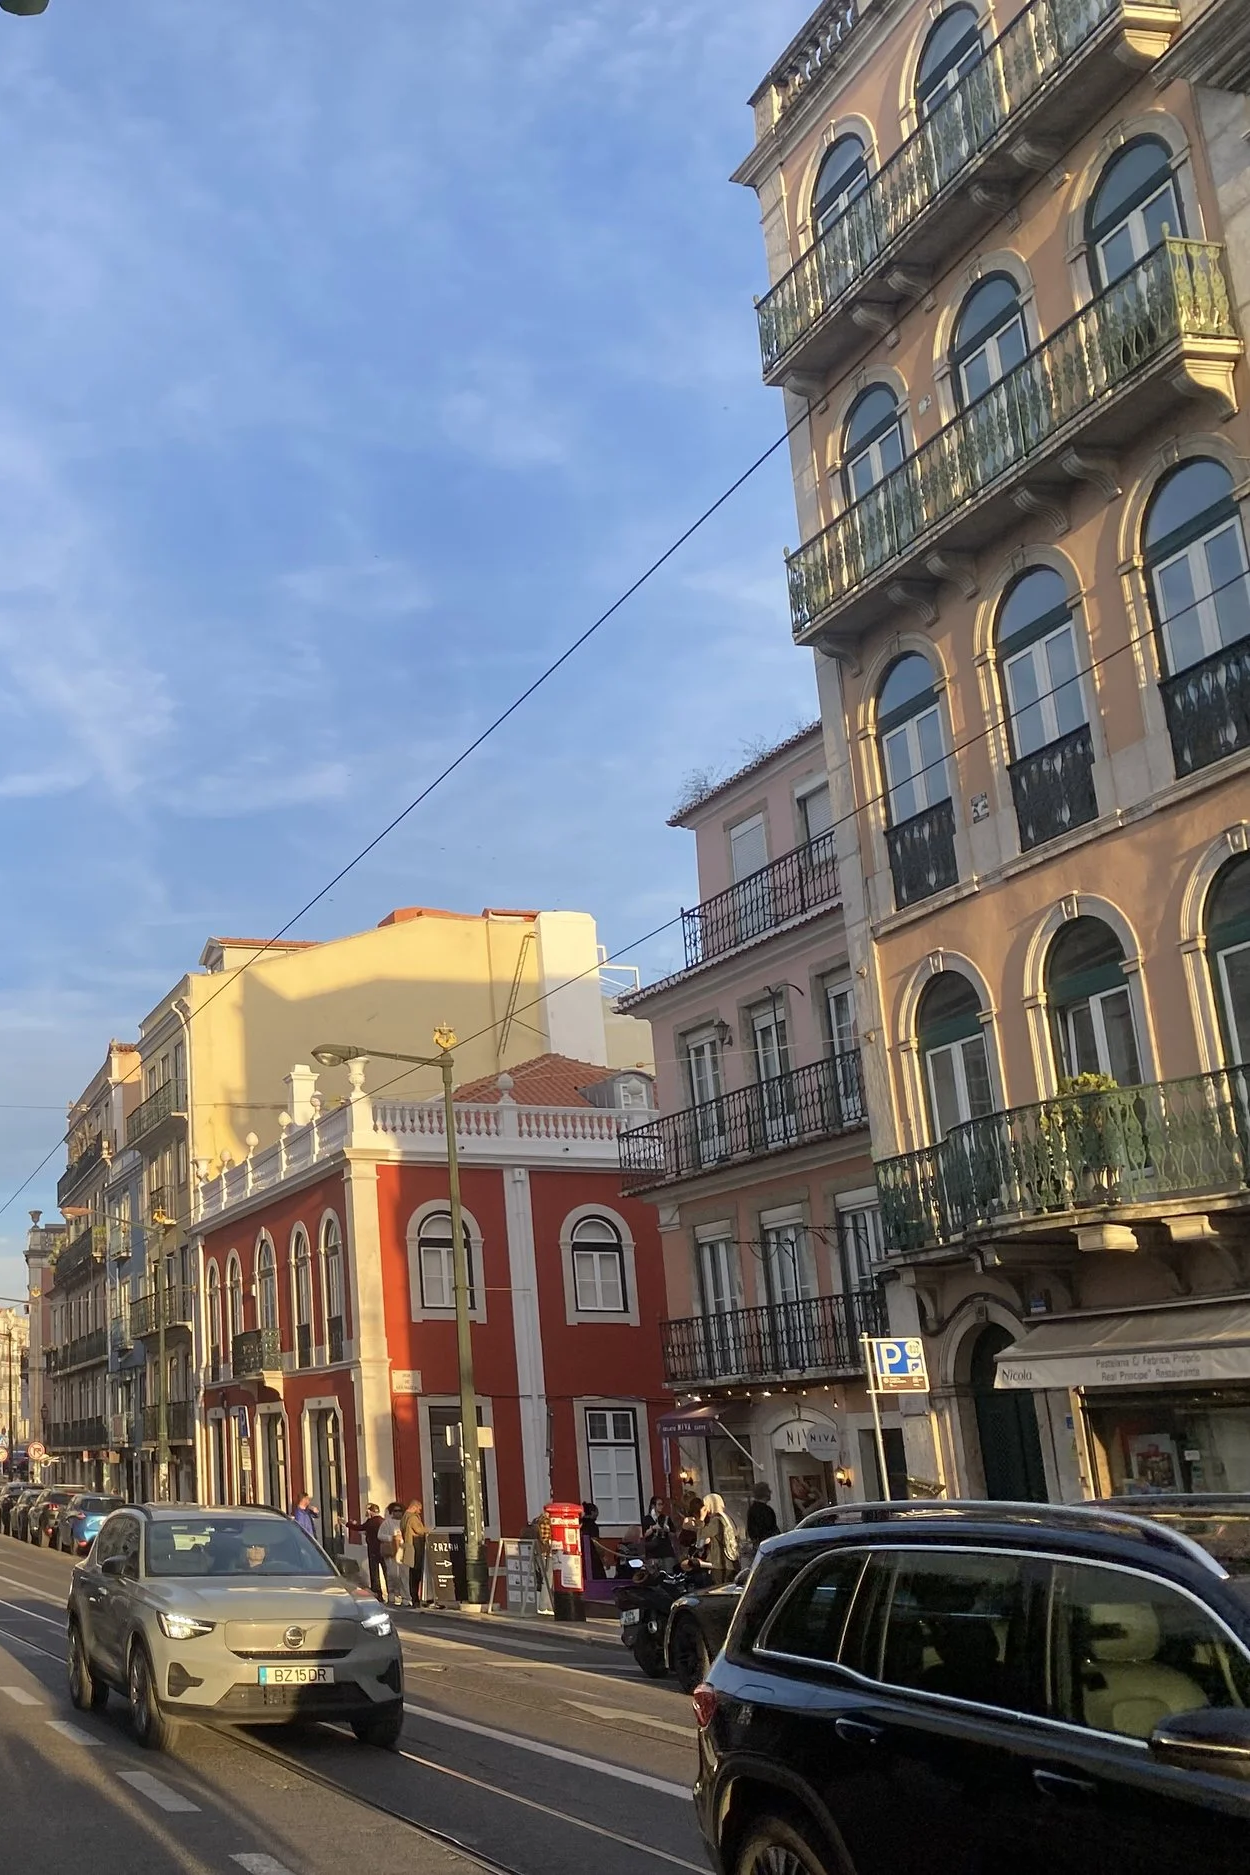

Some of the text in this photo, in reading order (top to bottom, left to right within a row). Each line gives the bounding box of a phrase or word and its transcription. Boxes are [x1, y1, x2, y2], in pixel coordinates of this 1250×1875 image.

[879, 1343, 902, 1374] P
[1002, 1368, 1032, 1381] Nicola
[1101, 1371, 1117, 1382] Real
[677, 1423, 692, 1431] NIVA
[810, 1433, 837, 1443] NIVA
